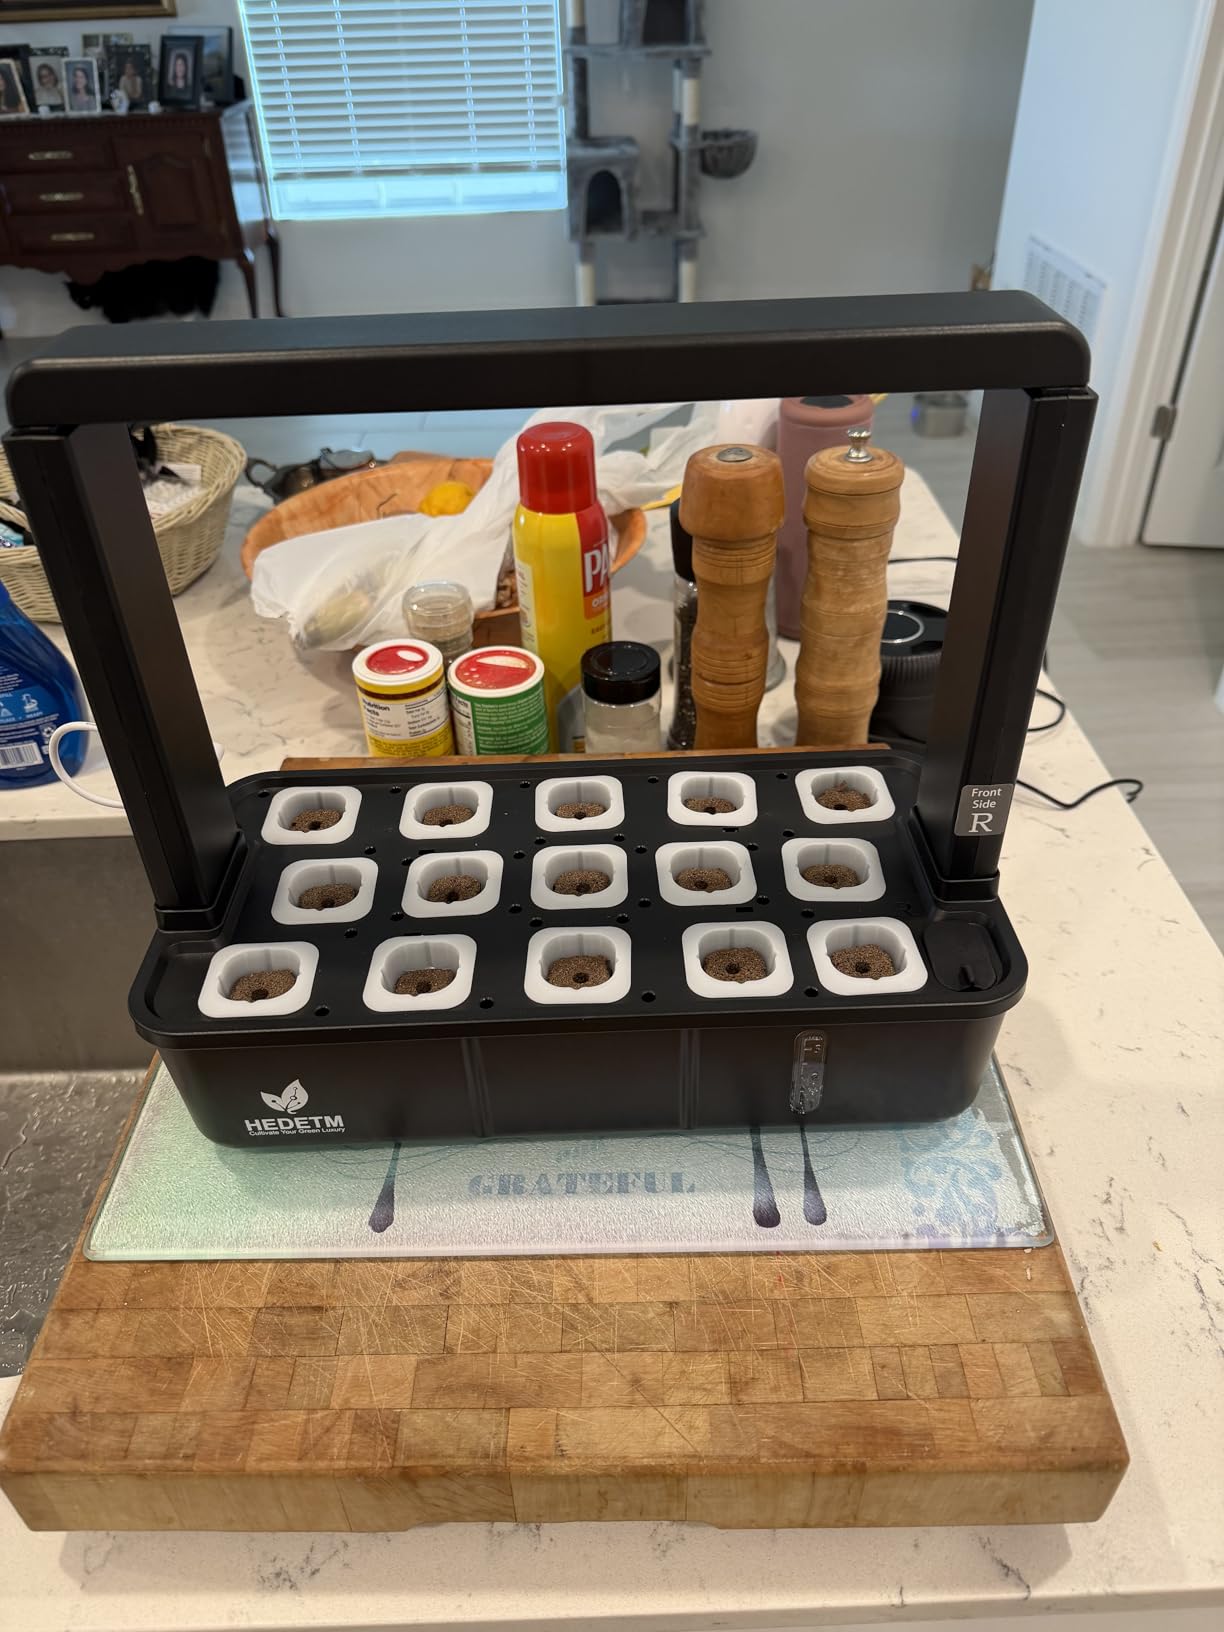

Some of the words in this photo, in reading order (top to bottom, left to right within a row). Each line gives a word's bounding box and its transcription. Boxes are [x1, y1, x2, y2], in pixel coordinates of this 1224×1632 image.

[971, 788, 1002, 797] Front
[972, 799, 997, 809] Side
[968, 812, 993, 833] R
[244, 1115, 344, 1131] HEDETM
[468, 1171, 696, 1195] GRATEFUL
